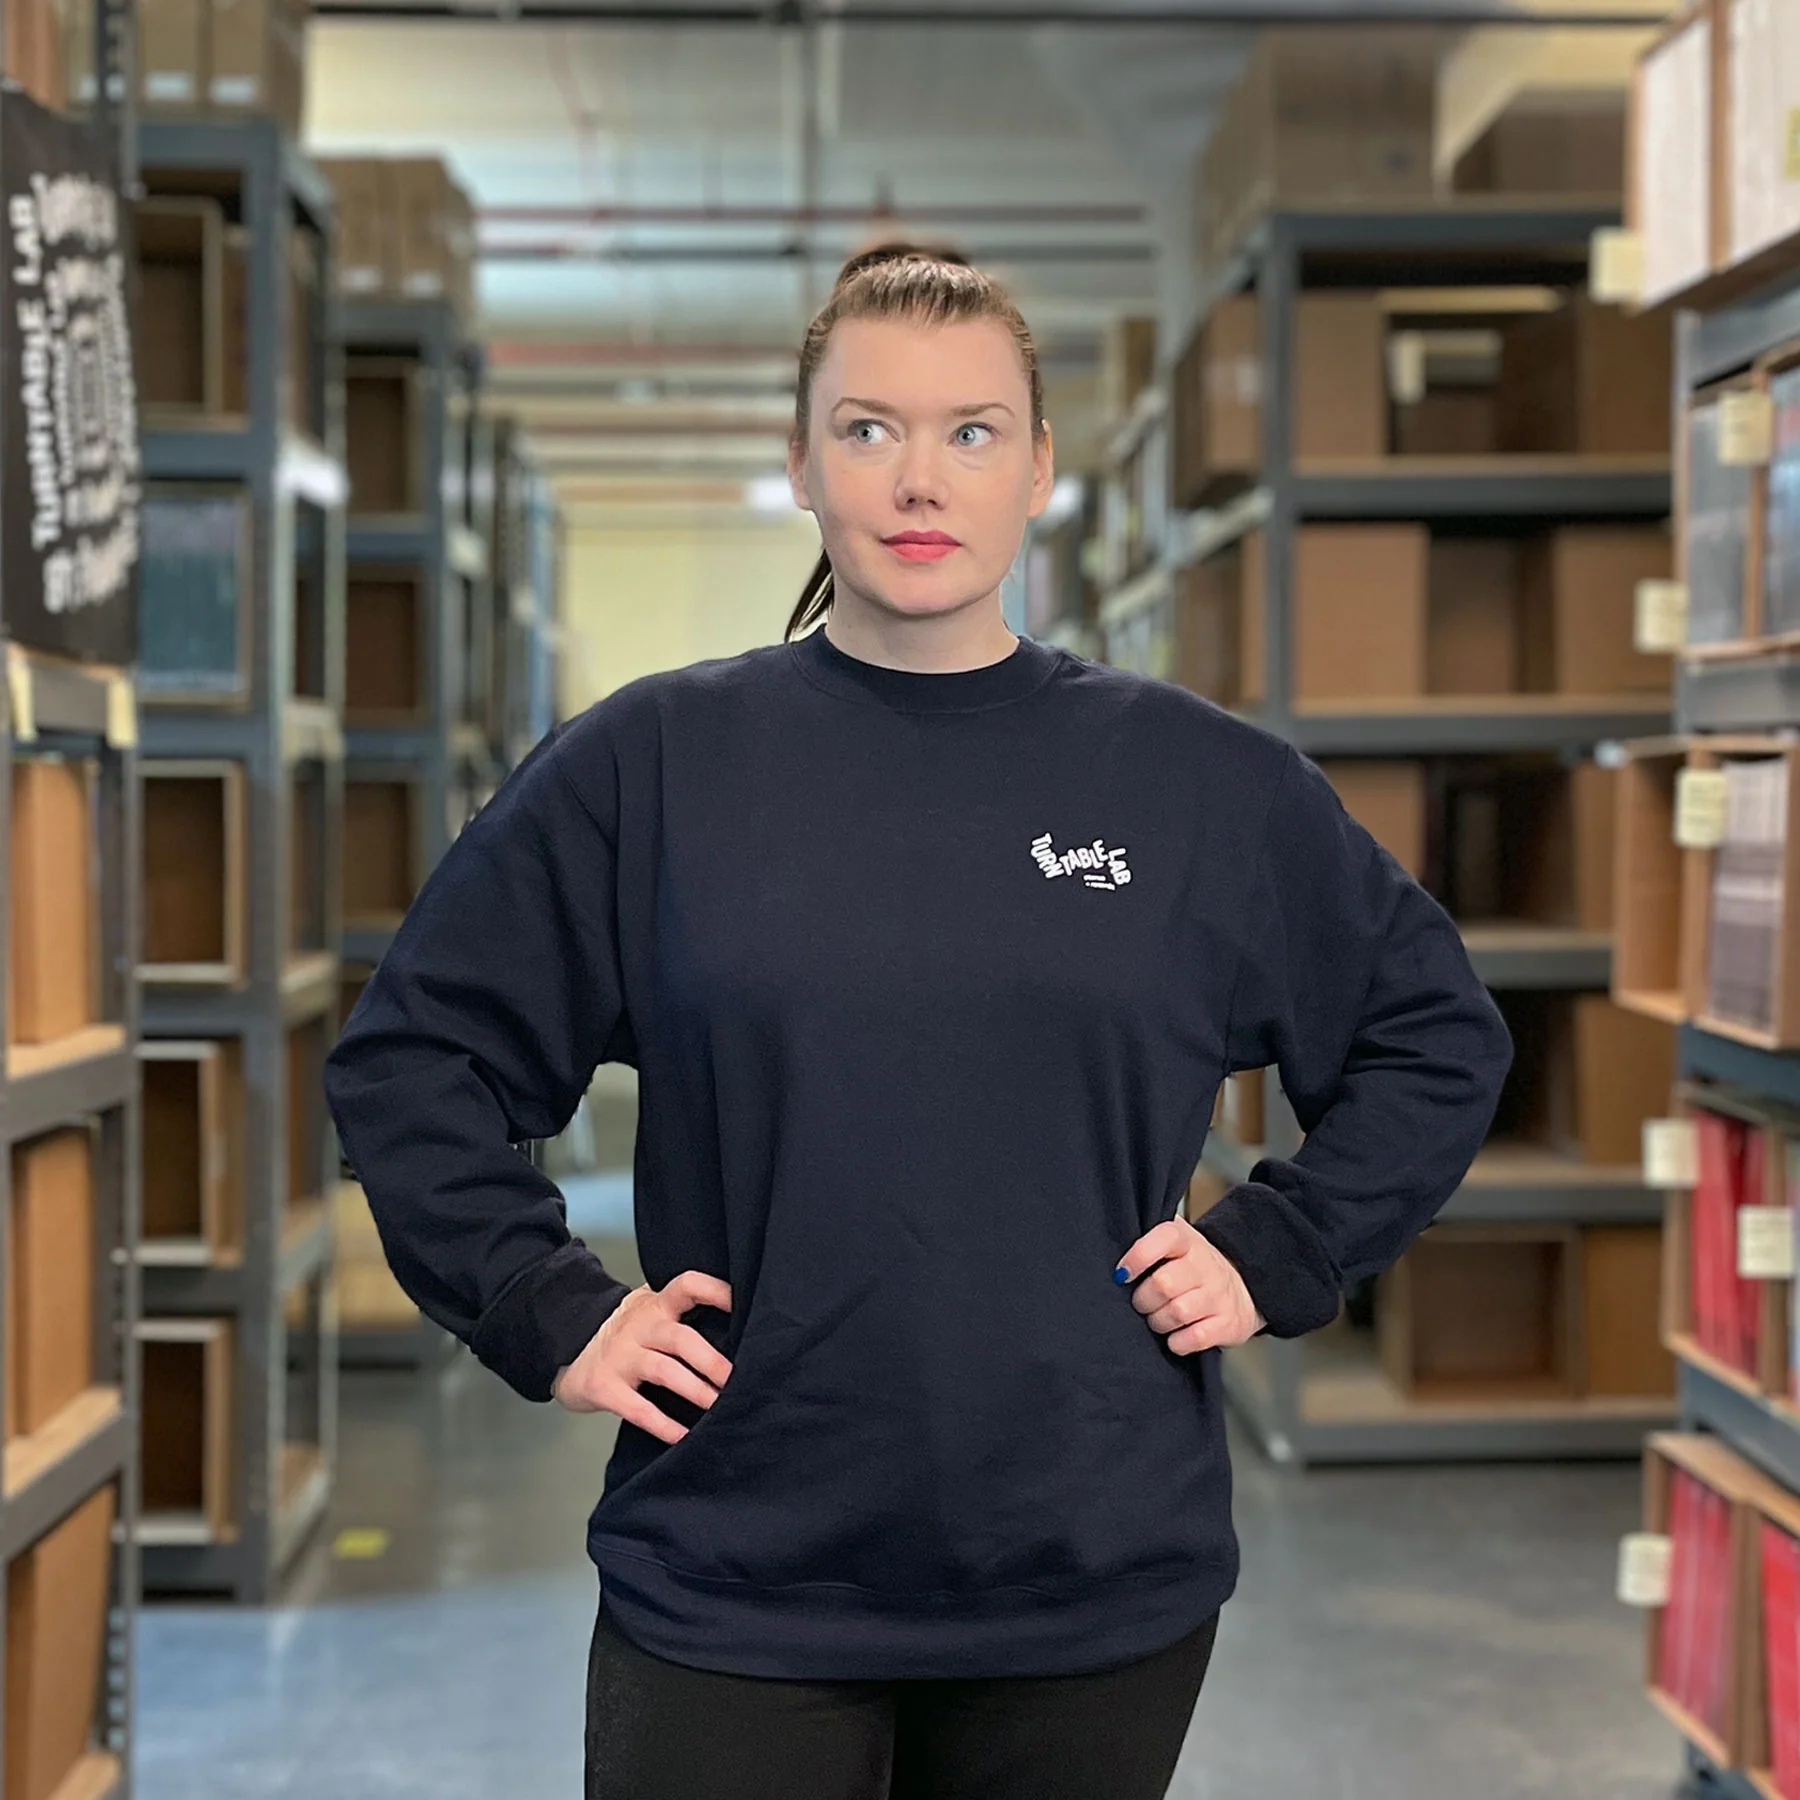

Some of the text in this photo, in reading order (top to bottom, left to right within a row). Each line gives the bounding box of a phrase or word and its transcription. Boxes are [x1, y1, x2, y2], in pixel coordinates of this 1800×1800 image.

[8, 194, 42, 285] LAB
[17, 298, 62, 550] TURNTABLE
[1107, 847, 1131, 885] LAB
